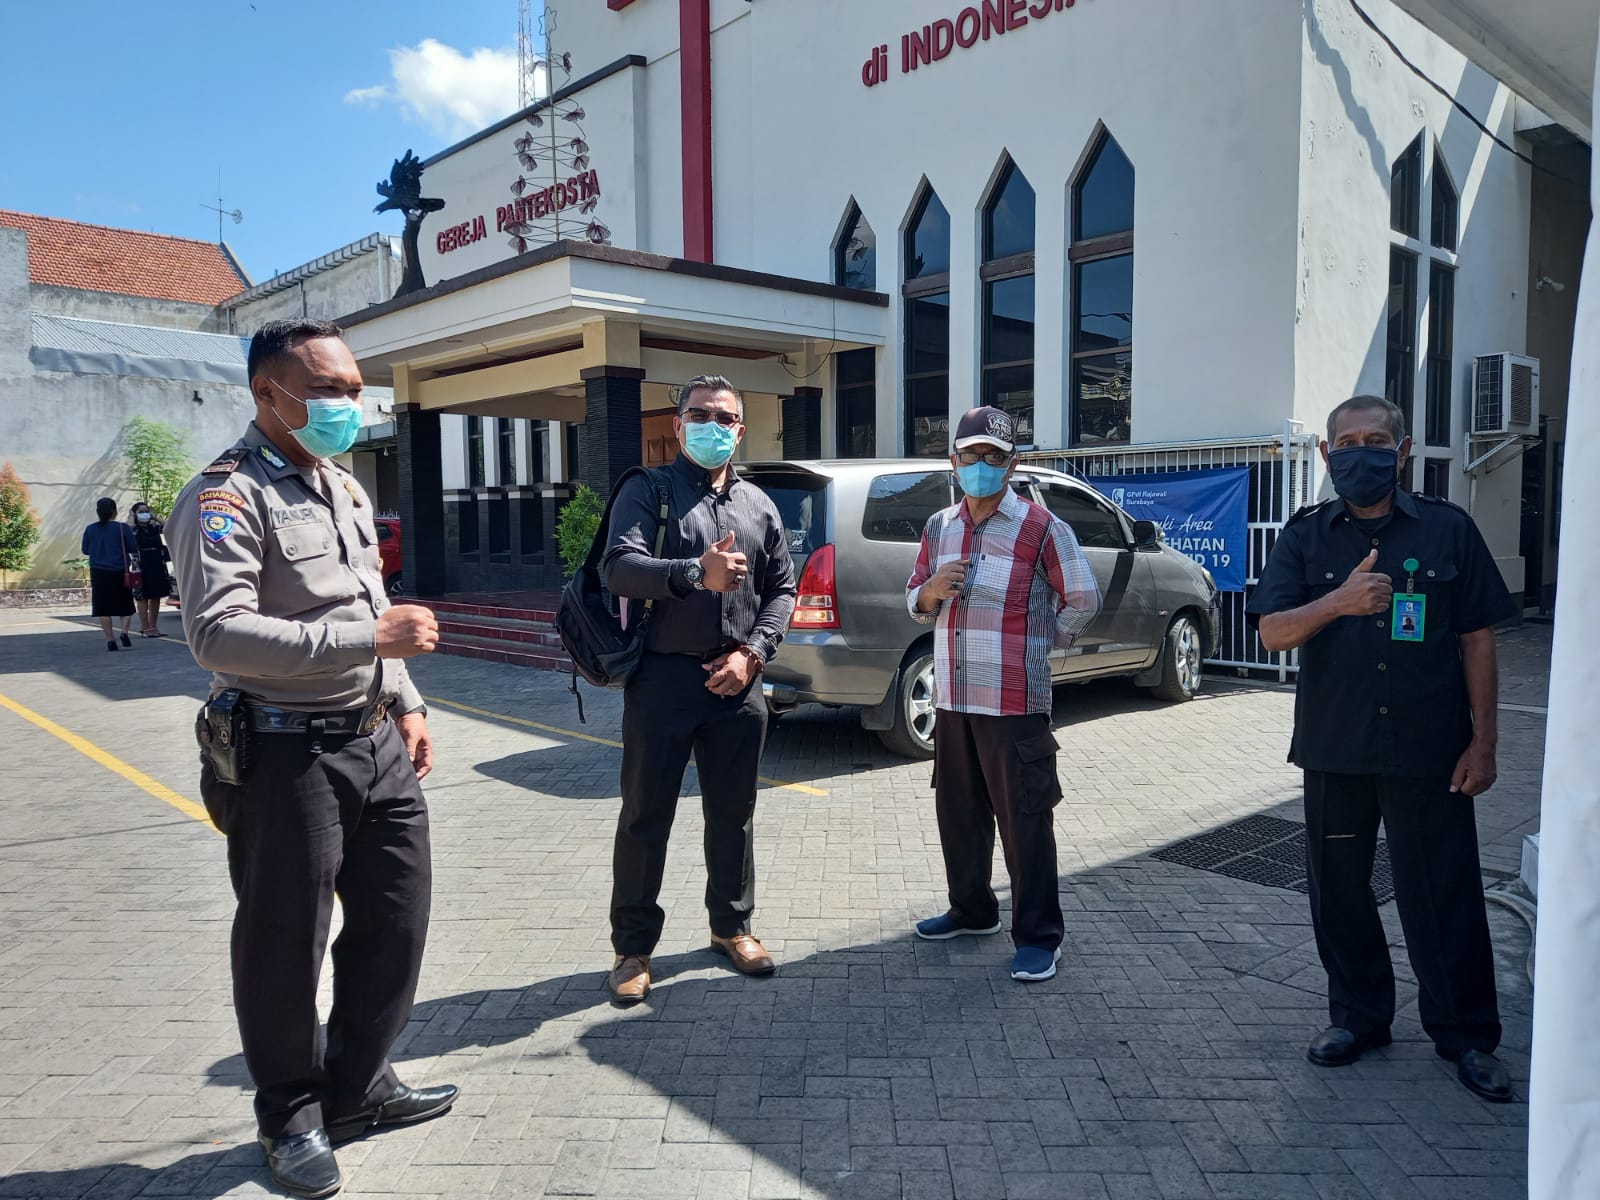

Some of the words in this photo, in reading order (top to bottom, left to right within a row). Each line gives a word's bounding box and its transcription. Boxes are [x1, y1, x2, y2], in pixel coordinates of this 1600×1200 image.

[862, 44, 888, 87] di
[901, 0, 1076, 73] INDONE
[437, 215, 488, 255] GEREJA
[496, 169, 601, 233] PANTEKOSTA
[988, 418, 1012, 435] VANS
[1126, 498, 1155, 507] Surabaya
[1142, 490, 1168, 499] Rajawali
[1178, 513, 1214, 534] Area
[1211, 553, 1231, 568] 19
